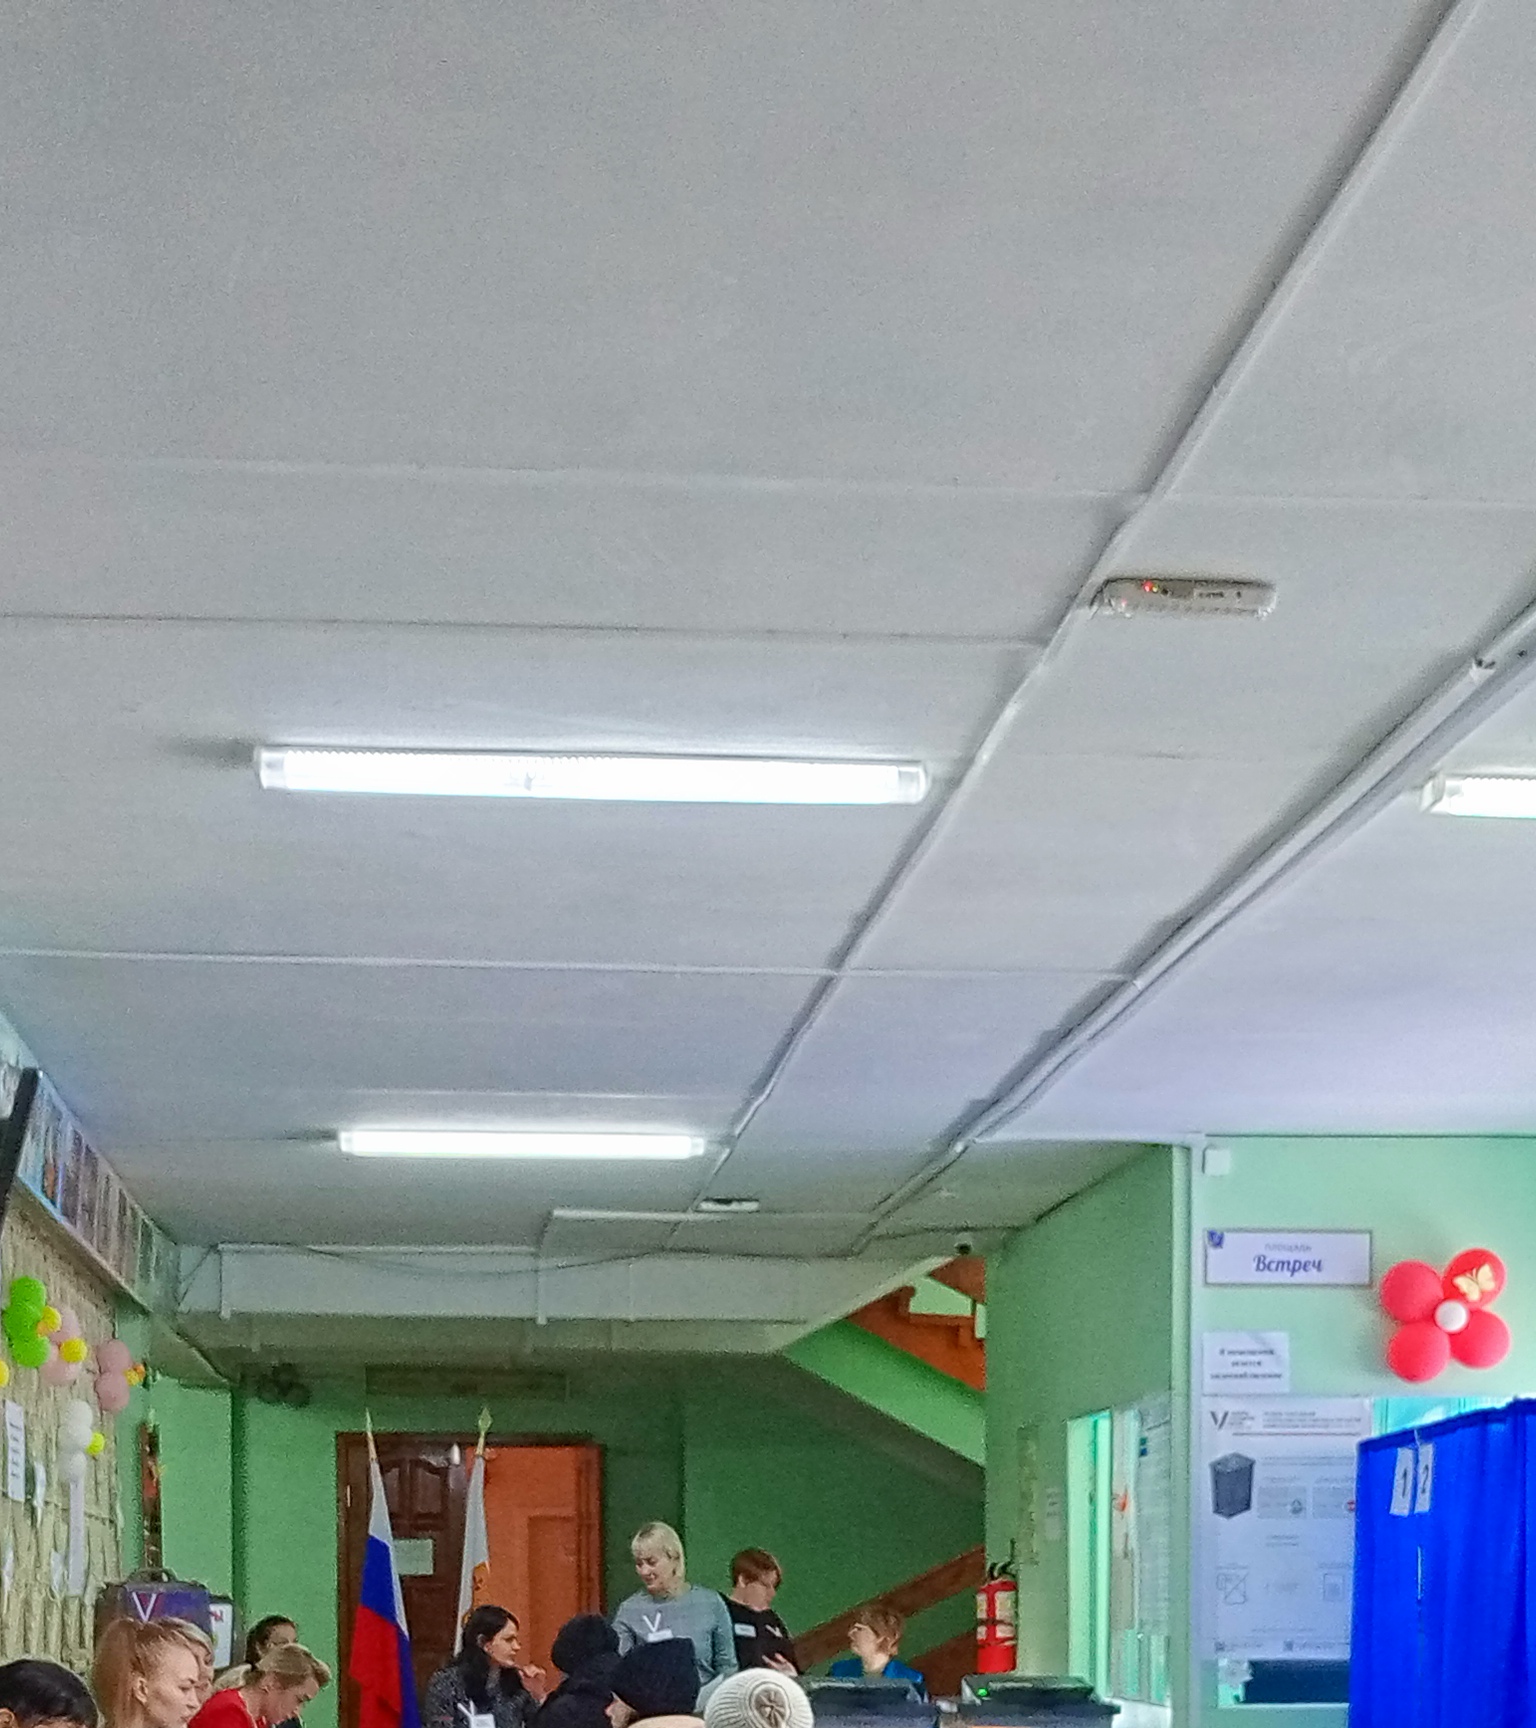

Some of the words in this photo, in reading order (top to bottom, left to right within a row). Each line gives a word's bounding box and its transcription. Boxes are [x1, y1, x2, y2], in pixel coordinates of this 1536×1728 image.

[1253, 1255, 1323, 1278] Встреч
[1401, 1468, 1408, 1498] 1
[1421, 1464, 1429, 1494] 2
